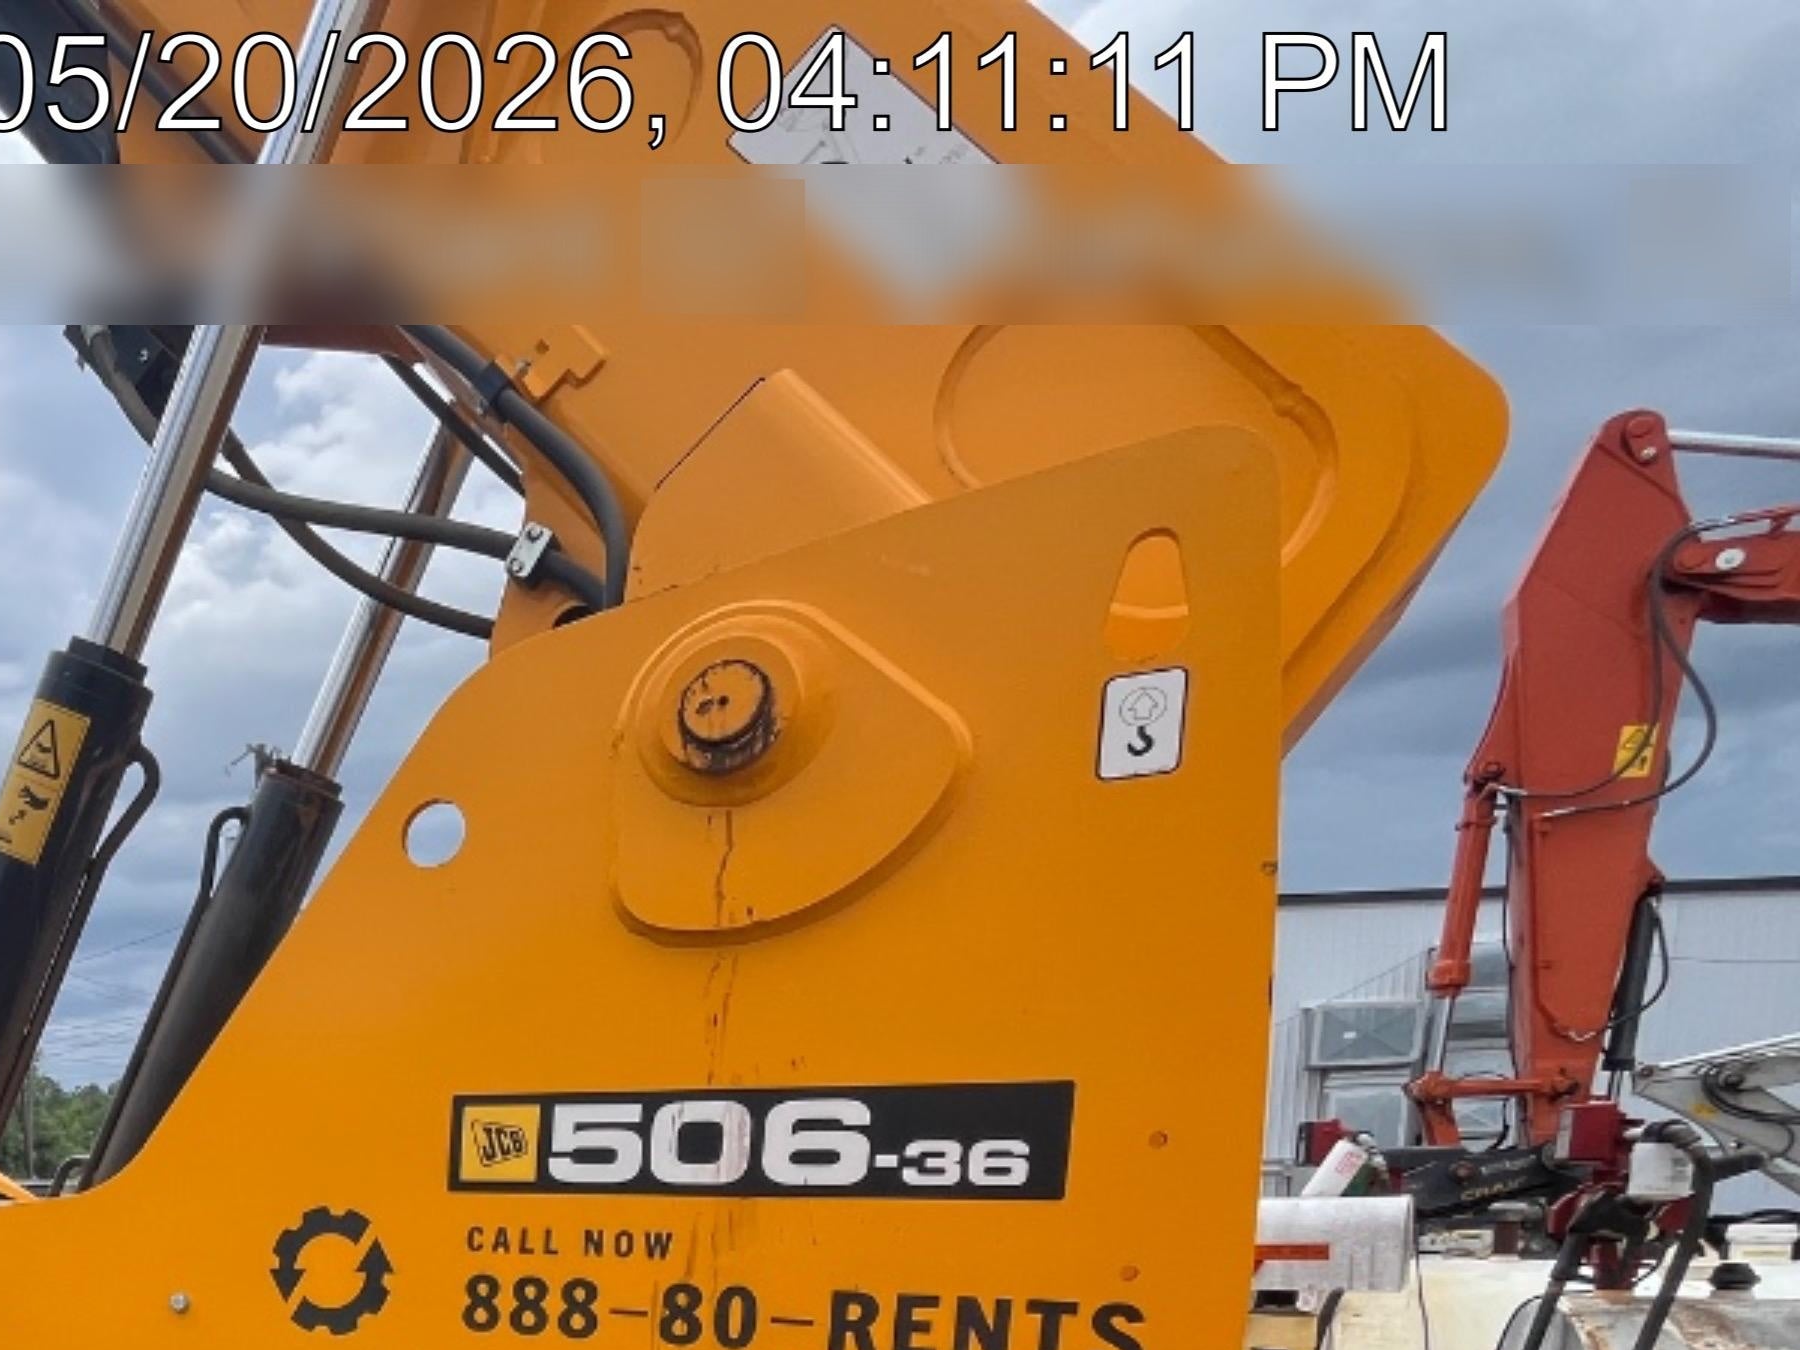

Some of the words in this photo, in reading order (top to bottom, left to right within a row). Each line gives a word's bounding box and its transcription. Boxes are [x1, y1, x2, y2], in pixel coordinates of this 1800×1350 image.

[547, 1097, 1031, 1187] 506-36
[466, 1226, 559, 1256] CALL
[584, 1228, 673, 1261] NOW
